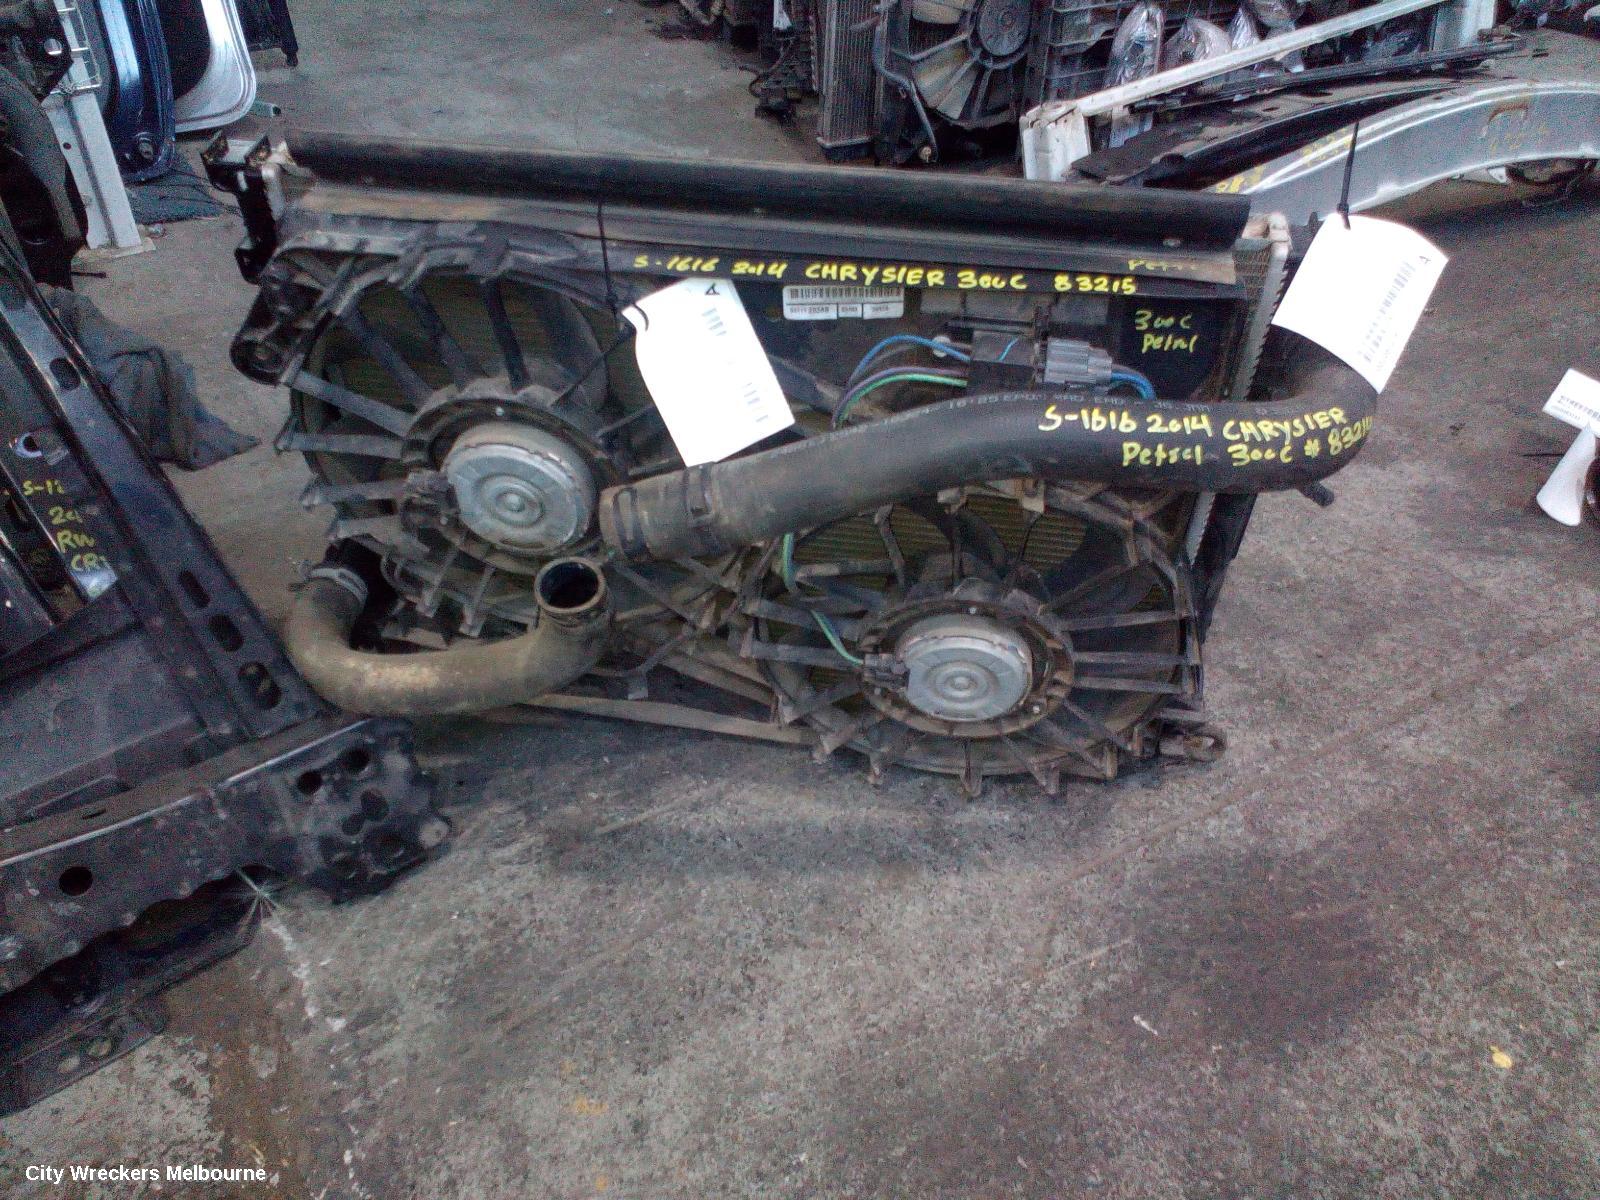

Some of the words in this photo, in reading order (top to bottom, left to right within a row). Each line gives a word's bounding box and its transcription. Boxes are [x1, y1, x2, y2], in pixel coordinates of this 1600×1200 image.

[957, 269, 1028, 290] 300C
[1053, 274, 1137, 295] 83215
[1146, 413, 1214, 438] 2014
